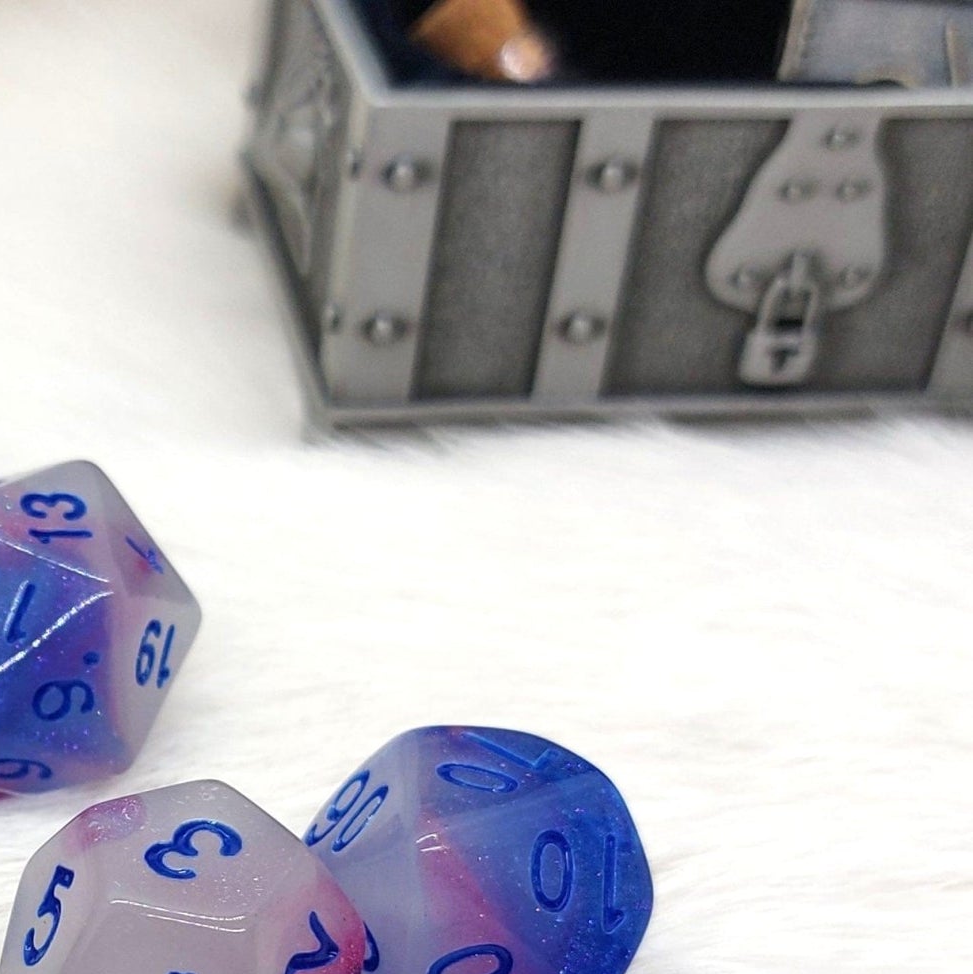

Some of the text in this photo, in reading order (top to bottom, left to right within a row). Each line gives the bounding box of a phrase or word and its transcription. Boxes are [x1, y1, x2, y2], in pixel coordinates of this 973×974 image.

[20, 492, 94, 545] 13
[135, 619, 175, 689] 19
[144, 818, 243, 880] 3
[530, 829, 628, 935] 10
[22, 864, 75, 967] 5
